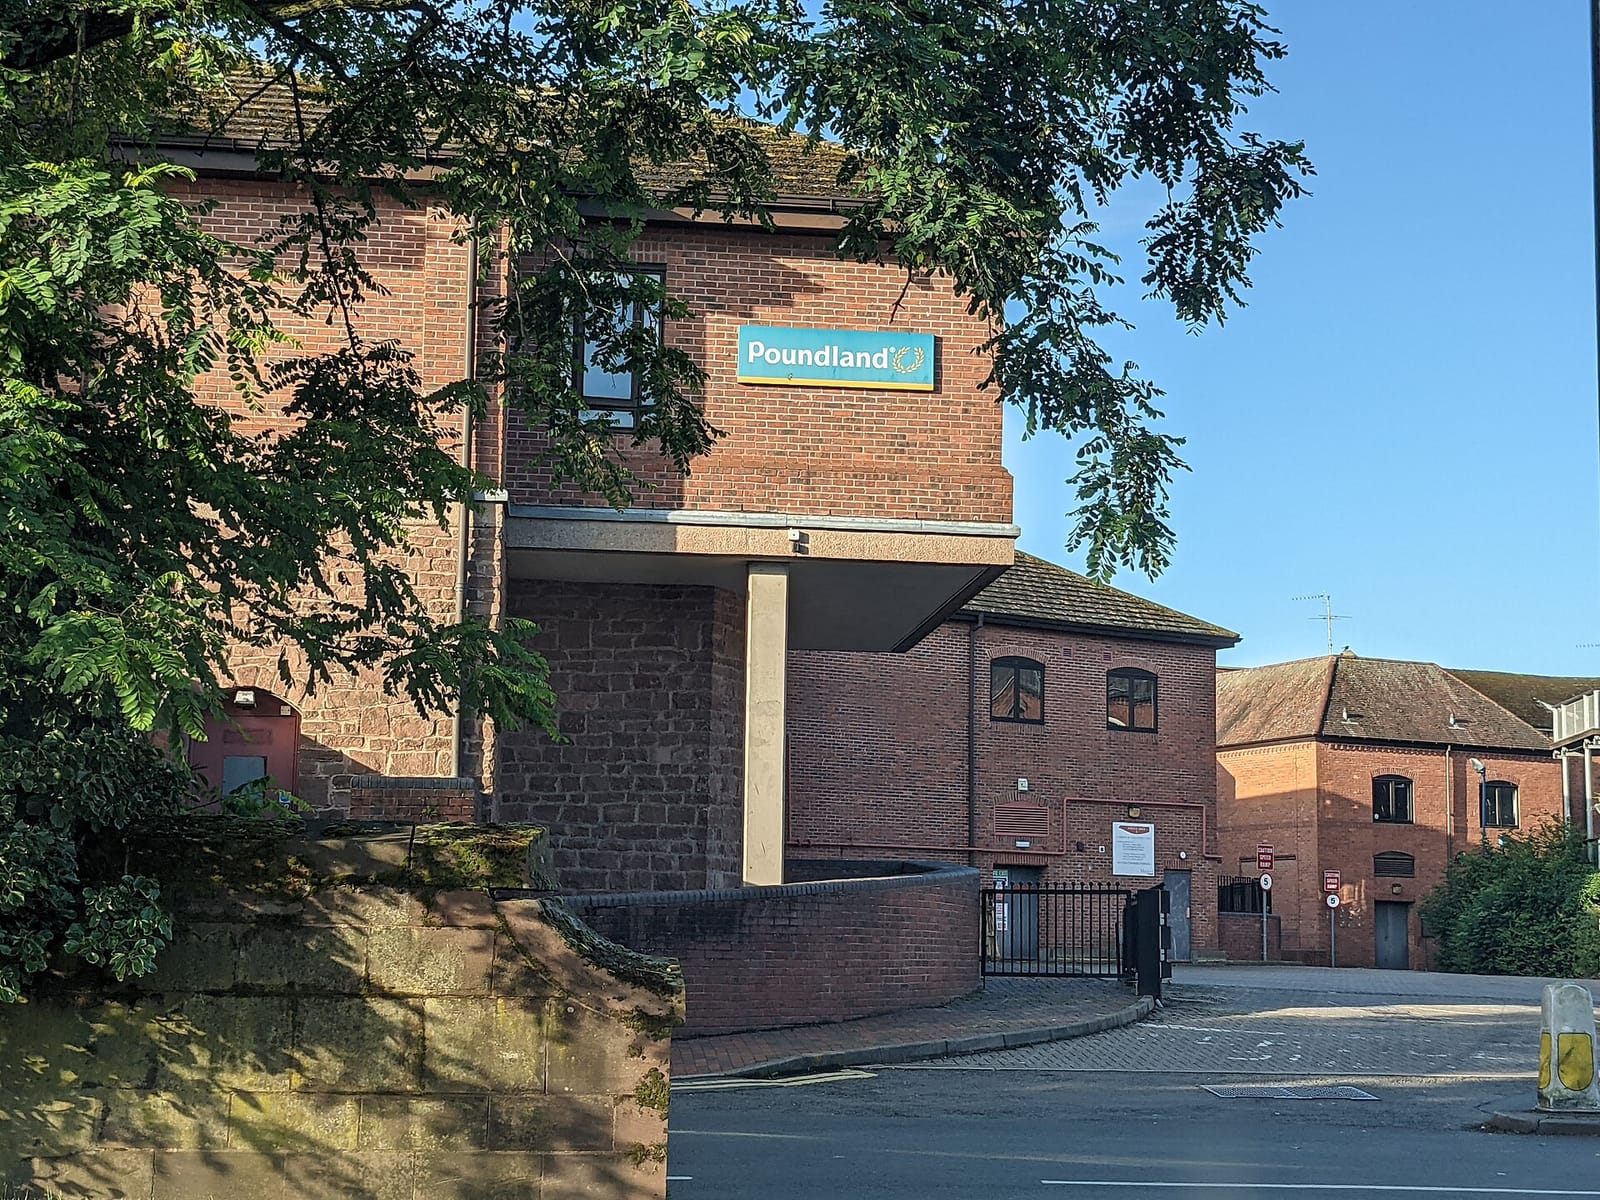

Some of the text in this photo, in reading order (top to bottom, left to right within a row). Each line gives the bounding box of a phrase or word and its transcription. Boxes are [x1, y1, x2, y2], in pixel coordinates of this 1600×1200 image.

[747, 340, 889, 369] Poundland
[1263, 877, 1269, 886] 5
[1330, 897, 1336, 905] 5
